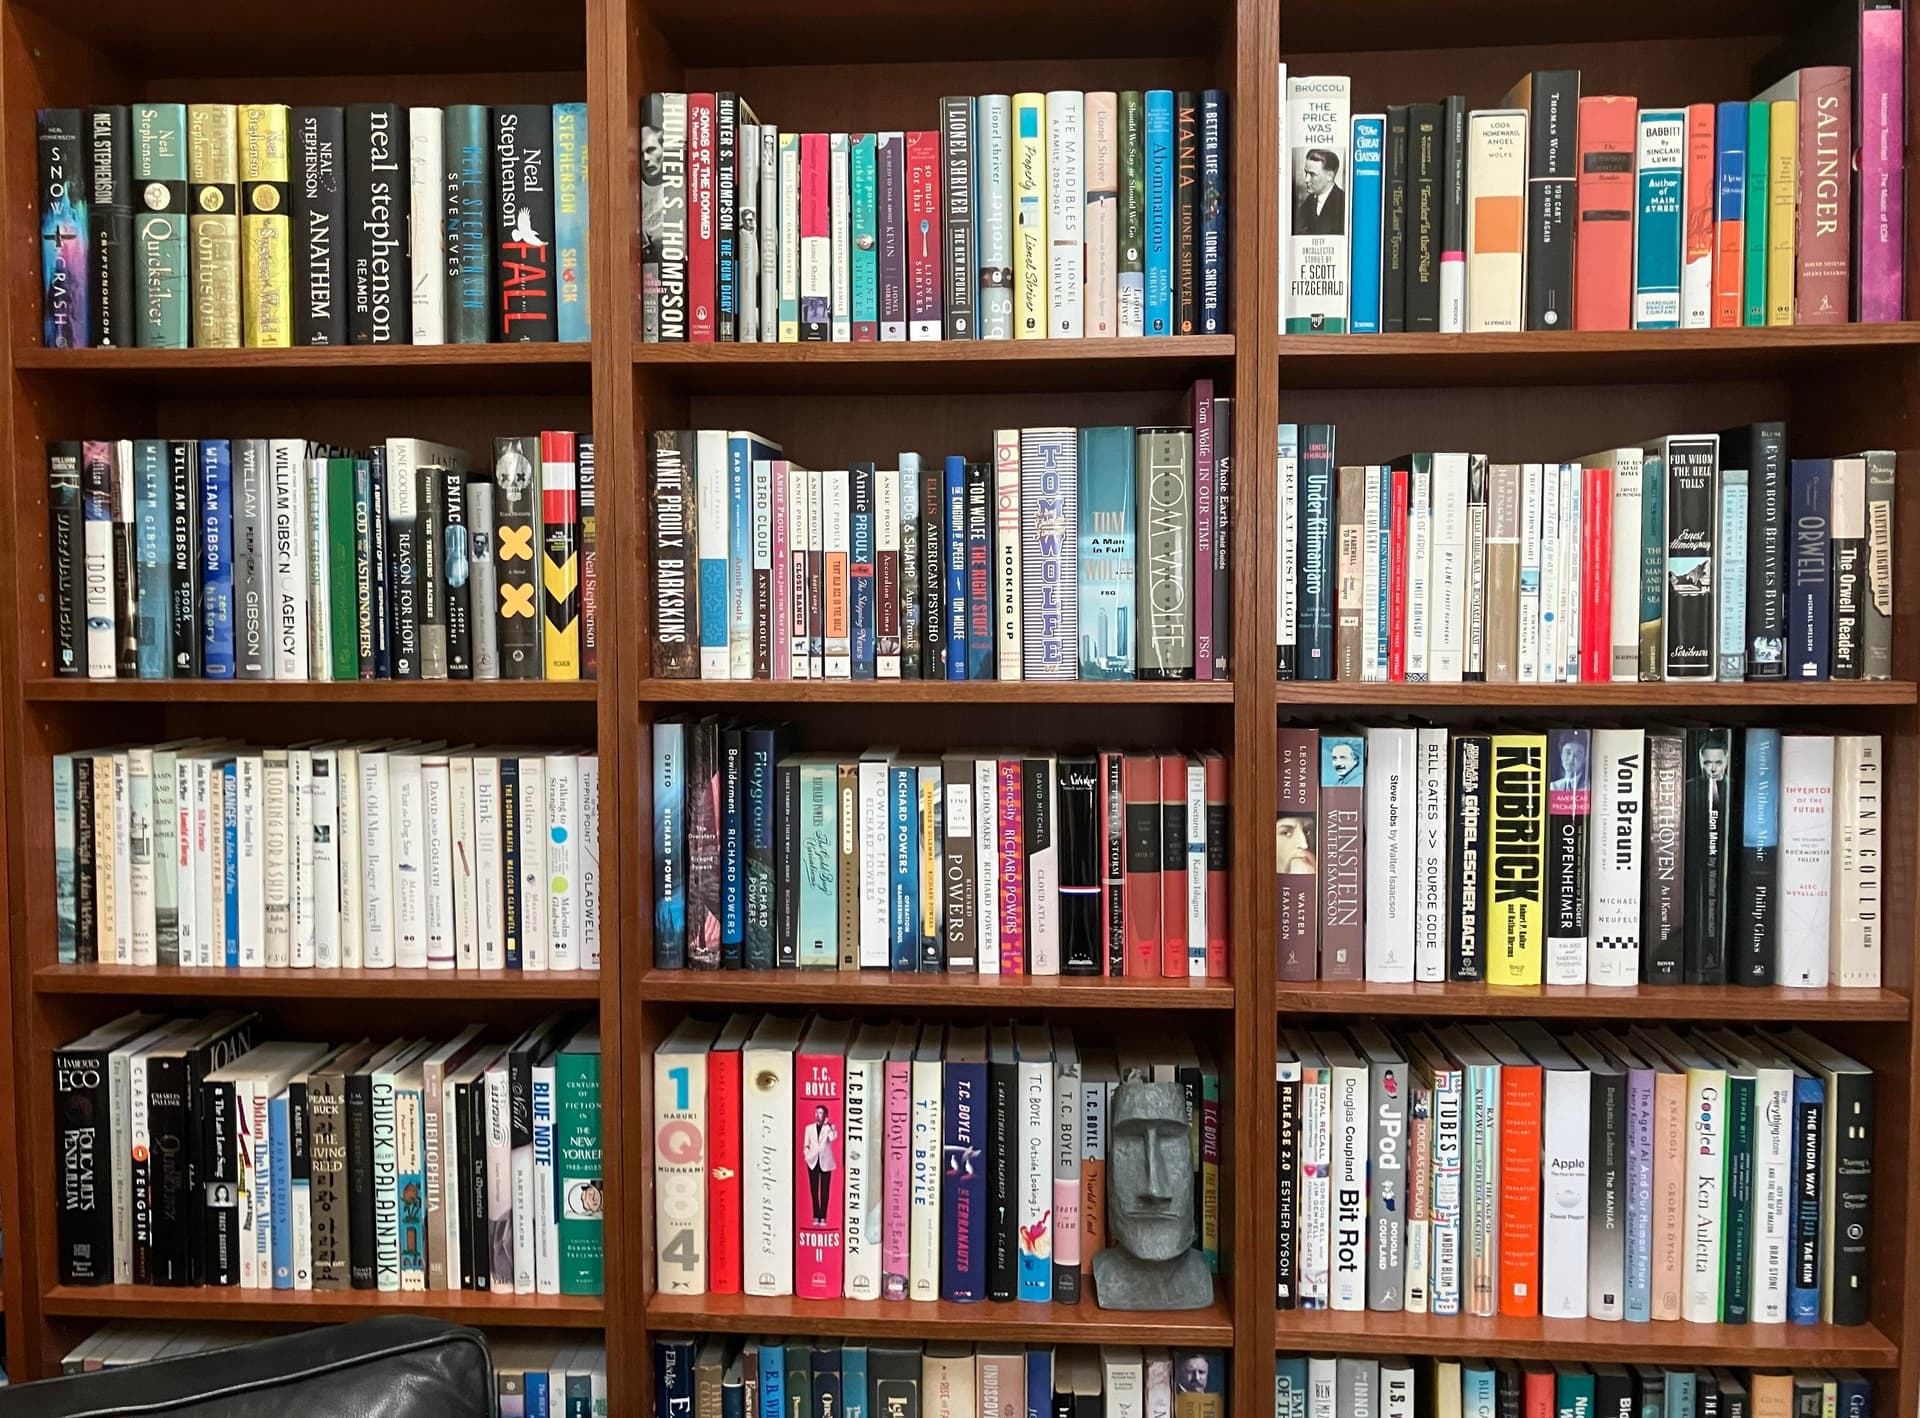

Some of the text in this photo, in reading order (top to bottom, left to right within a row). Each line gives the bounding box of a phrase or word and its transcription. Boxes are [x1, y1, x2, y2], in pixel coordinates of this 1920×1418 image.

[1206, 112, 1217, 150] BETTER
[1303, 113, 1336, 122] PRICE
[1305, 135, 1334, 144] HIGH
[1307, 124, 1332, 133] WAS
[1309, 103, 1331, 111] THE
[1646, 127, 1680, 137] BABBITT
[139, 110, 157, 176] Stephenson
[158, 130, 174, 157] Neal
[304, 118, 317, 199] STEPHENSON
[320, 142, 332, 176] NEAL
[497, 114, 519, 227] Stephenson
[524, 149, 543, 192] Neal
[949, 111, 968, 214] LIONEL SHRIVER
[1065, 105, 1077, 231] THE MANDIBLES
[1178, 107, 1195, 188] MANIA
[1207, 154, 1217, 175] LIFE
[1817, 96, 1838, 238] SALINGER
[51, 147, 65, 214] SNOW
[1152, 143, 1163, 253] Abominations
[1645, 205, 1680, 213] STREET
[364, 112, 399, 343] neal stephenson
[448, 173, 458, 276] SEVENEVES
[662, 100, 686, 338] HUNTER S. THOMPSON
[53, 252, 68, 325] CRASH
[100, 231, 110, 335] CRYPTONOMICON
[142, 218, 172, 326] Quicksilver
[310, 211, 330, 318] ANATHEM
[357, 259, 367, 313] REAMDE
[502, 242, 547, 333] FALL
[721, 239, 731, 314] THE RUM DIARY
[1291, 281, 1343, 296] FITZGERALD
[1301, 265, 1336, 279] F. SCOTT
[1199, 399, 1209, 457] Tom Wolfe
[1670, 455, 1713, 465] FOR WHOM
[276, 447, 288, 508] WILLIAM
[448, 476, 459, 522] ENIAC
[1307, 475, 1327, 515] Under
[1673, 467, 1711, 477] THE BELL
[1680, 479, 1704, 488] TOLLS
[174, 447, 186, 570] WILLIAM GIBSON
[758, 476, 767, 558] BIRD CLOUD
[856, 470, 867, 564] Annie PROULX
[1198, 468, 1209, 551] IN OUR TIME
[87, 555, 105, 605] IDORU
[657, 449, 685, 643] ANNIE PROULX BARKSKINS
[1303, 517, 1327, 594] Kilimanjaro
[1798, 517, 1825, 586] ORWELL
[182, 583, 190, 621] spook
[399, 533, 413, 655] REASON FOR HOPE
[928, 523, 938, 642] AMERICAN PSYCHO
[971, 546, 988, 636] THE RIGHT STUFF
[1837, 548, 1857, 660] The Orwell Reader
[283, 594, 295, 656] AGENCY
[1007, 622, 1013, 639] UP
[479, 784, 492, 823] blink
[728, 749, 737, 814] Bewilderment
[1002, 768, 1014, 821] generosity
[1390, 775, 1398, 801] Steve
[1428, 744, 1438, 820] BILL GATES
[1617, 755, 1639, 794] Von
[728, 829, 736, 882] RICHARD
[1388, 830, 1397, 842] by
[1389, 842, 1397, 873] Walter
[1495, 746, 1541, 903] KUBRICK
[1616, 800, 1637, 870] Braun:
[1659, 770, 1674, 880] BEETHOVEN
[949, 855, 965, 942] POWERS
[1337, 809, 1357, 927] EINSTEIN
[1389, 876, 1397, 919] Isaacson
[1561, 824, 1574, 929] OPPENHEIMER
[585, 872, 594, 943] GLADWELL
[1427, 858, 1438, 948] SOURCE CODE
[58, 1070, 99, 1092] ECO
[134, 1067, 144, 1139] CLASSIC
[805, 1082, 836, 1096] BOYLE
[253, 1096, 267, 1139] Didion
[534, 1082, 551, 1167] BLUE NOTE
[1061, 1093, 1072, 1167] T.C. BOYLE
[1282, 1087, 1291, 1170] RELEASE 2.0
[1342, 1079, 1356, 1181] Douglas Coupland
[1379, 1104, 1402, 1170] JPod
[1440, 1100, 1457, 1152] TUBES
[1696, 1088, 1717, 1155] Googled
[372, 1084, 397, 1275] CHUCK PALAHNIUK
[1552, 1158, 1584, 1172] Apple
[1805, 1109, 1817, 1196] THE NVIDIA WAY
[136, 1169, 147, 1241] PENGUIN
[849, 1168, 859, 1254] RIVEN ROCK
[1280, 1181, 1291, 1276] ESTHER DYSON
[1339, 1190, 1359, 1272] Bit Rot
[800, 1233, 839, 1247] STORIES
[1803, 1241, 1814, 1283] TAE KIM
[1316, 1383, 1330, 1399] BEN
[1390, 1381, 1405, 1407] U.S.
